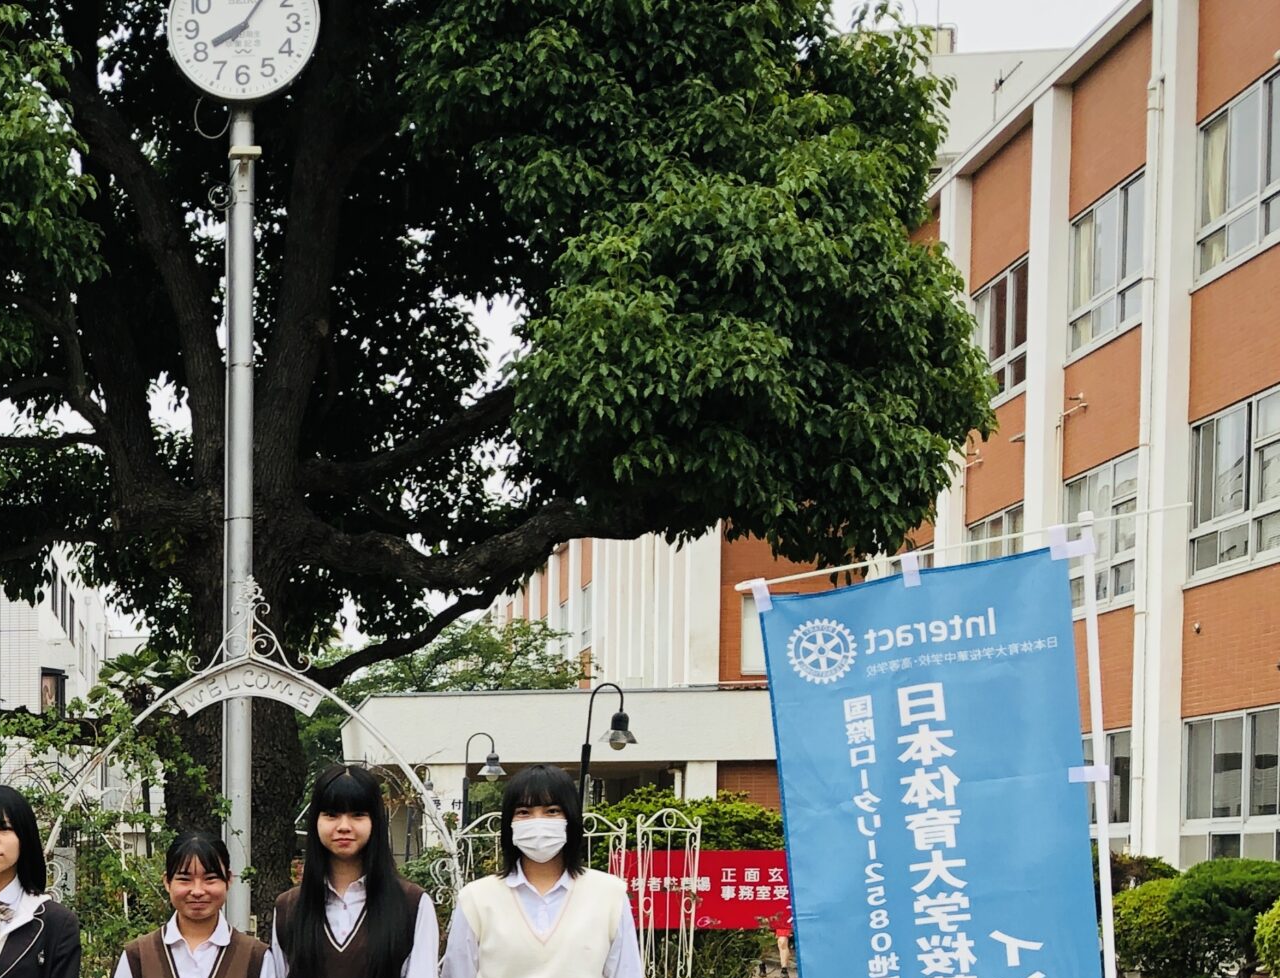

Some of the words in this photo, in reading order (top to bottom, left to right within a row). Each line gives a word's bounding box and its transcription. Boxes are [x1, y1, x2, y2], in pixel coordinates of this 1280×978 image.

[191, 0, 212, 15] 10
[184, 19, 200, 40] 9
[286, 12, 301, 33] 3
[193, 41, 209, 63] 8
[278, 37, 294, 58] 4
[213, 60, 228, 81] 7
[235, 64, 250, 86] 6
[260, 57, 276, 78] 5
[183, 669, 315, 710] WELCOME
